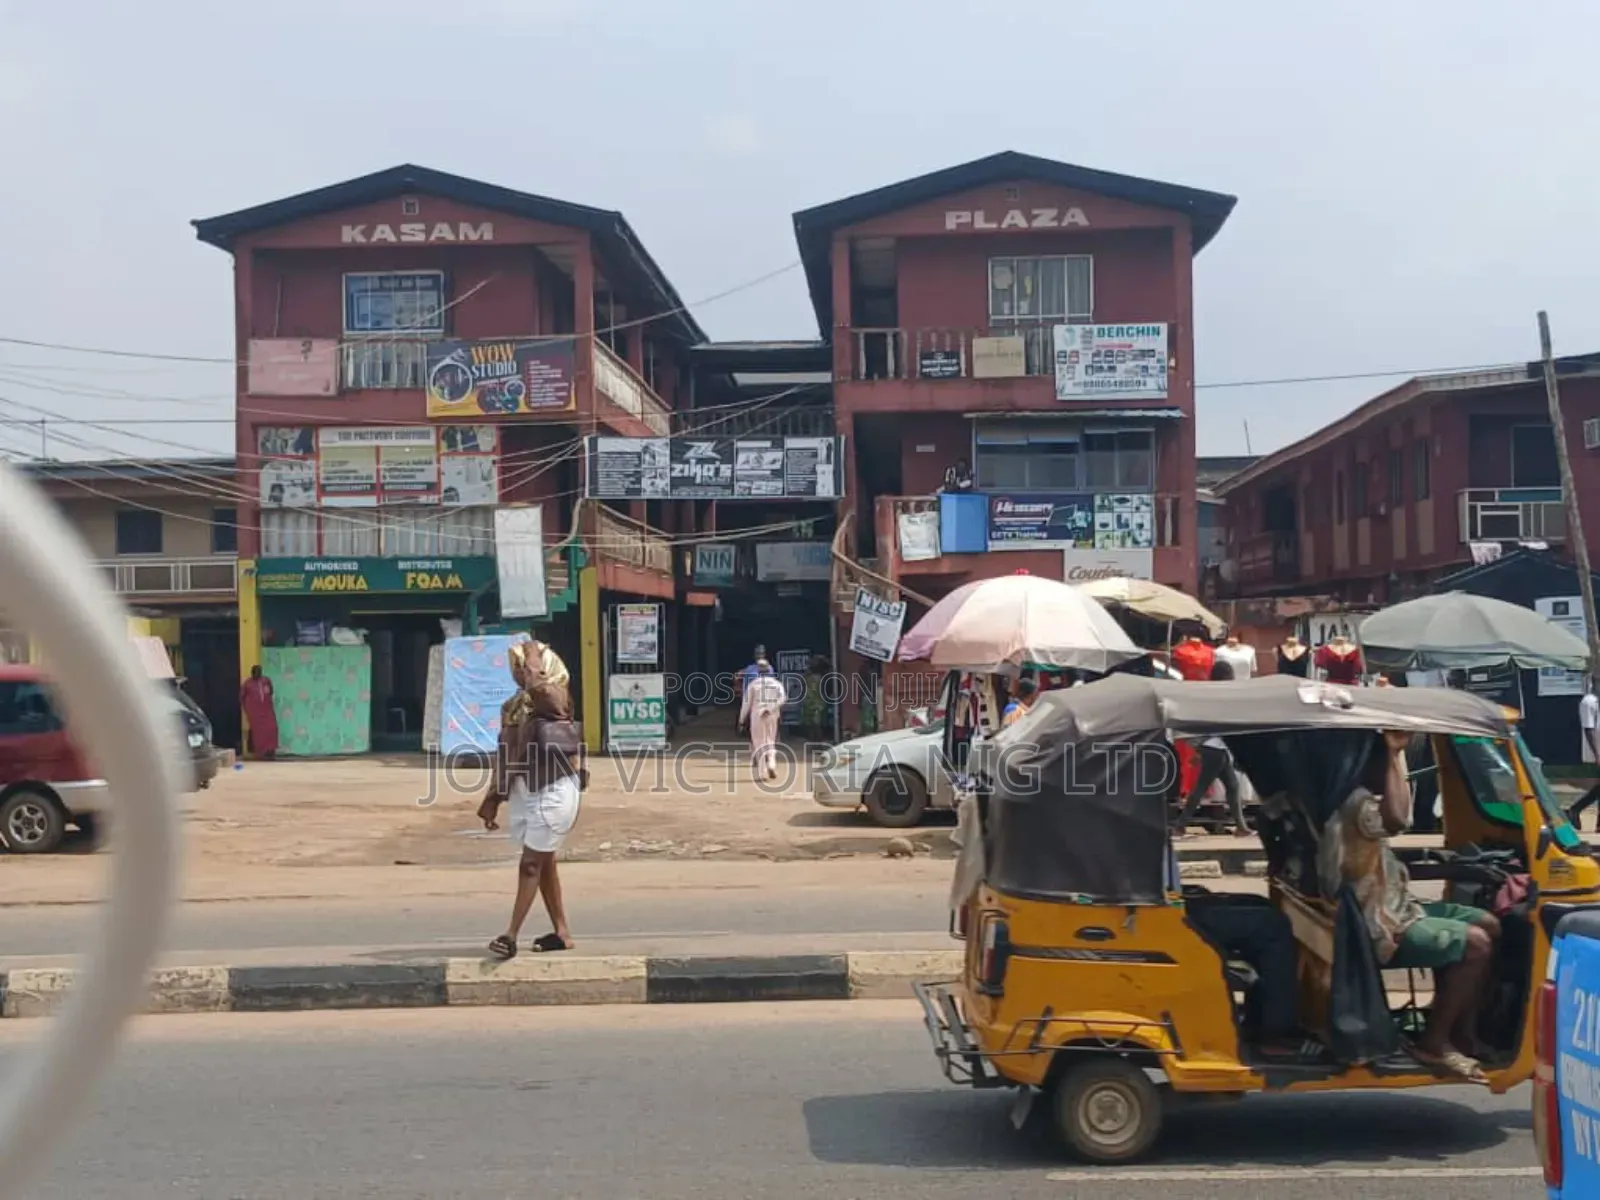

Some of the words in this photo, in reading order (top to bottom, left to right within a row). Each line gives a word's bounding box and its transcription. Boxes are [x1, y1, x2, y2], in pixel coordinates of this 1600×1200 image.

[945, 207, 1090, 230] PLAZA
[341, 221, 494, 244] KASAM
[1097, 325, 1161, 338] BERCHIN
[471, 342, 516, 366] WOW
[470, 361, 518, 378] STUDIO
[699, 550, 732, 569] NIN
[310, 573, 369, 591] MOUKA
[406, 571, 464, 590] FOAM
[859, 592, 901, 616] NYSC
[613, 701, 661, 719] NYSC
